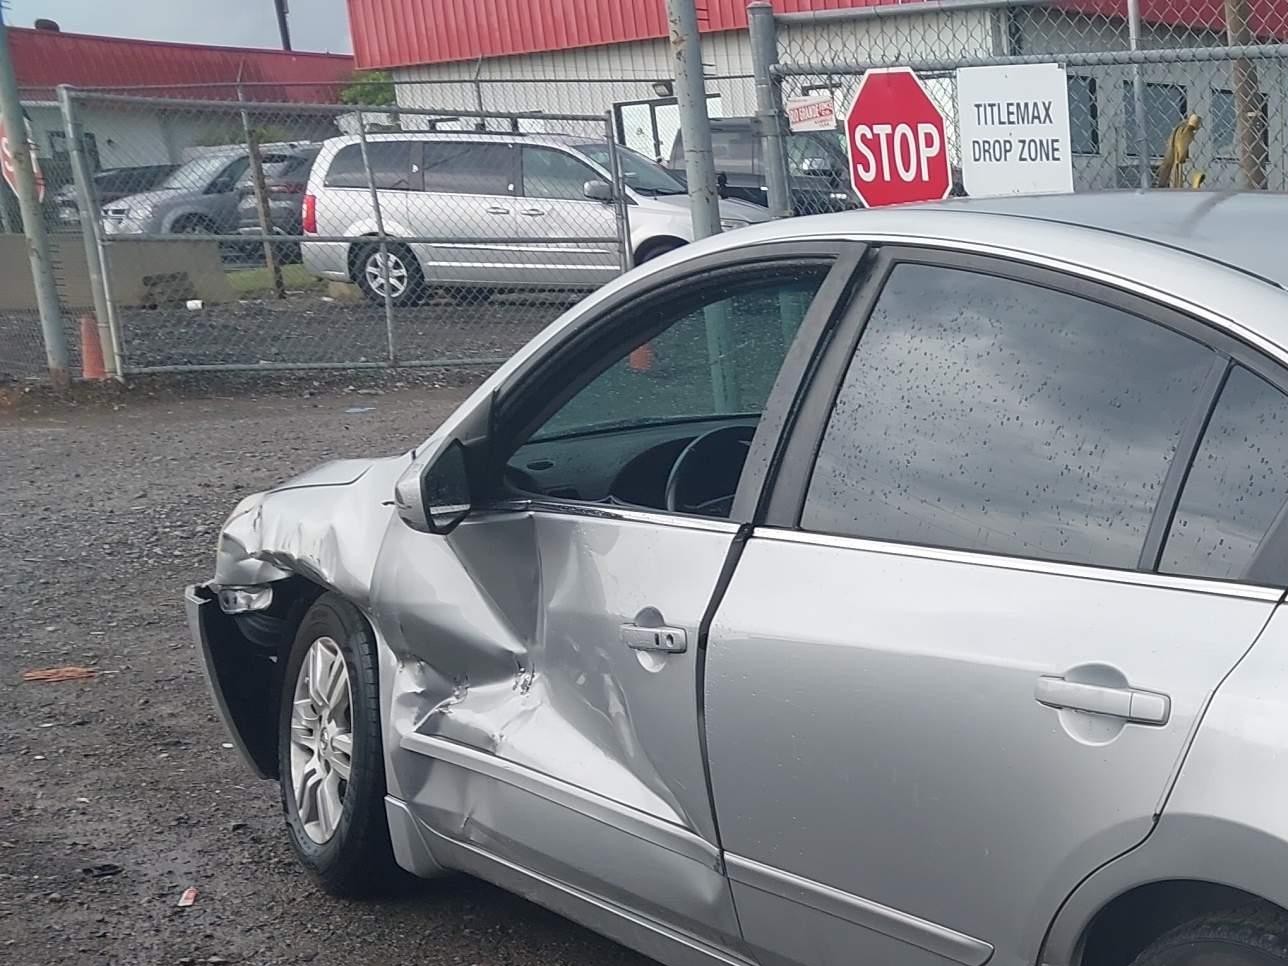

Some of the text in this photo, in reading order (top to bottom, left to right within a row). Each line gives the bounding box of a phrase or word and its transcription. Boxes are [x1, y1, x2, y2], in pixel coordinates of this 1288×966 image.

[975, 101, 1053, 125] TITLEMAX
[854, 123, 940, 183] STOP
[972, 138, 1061, 162] DROP ZONE
